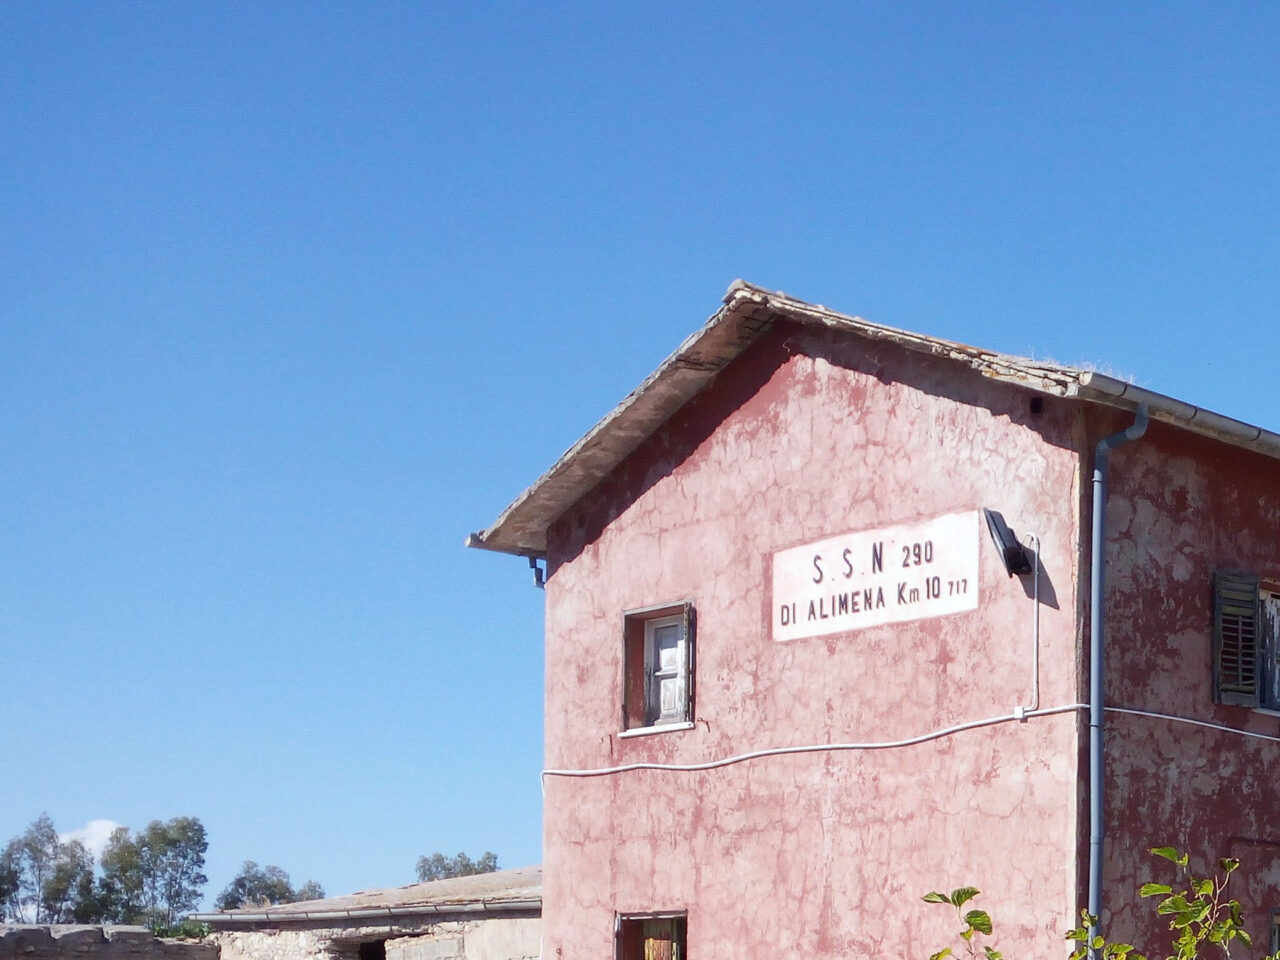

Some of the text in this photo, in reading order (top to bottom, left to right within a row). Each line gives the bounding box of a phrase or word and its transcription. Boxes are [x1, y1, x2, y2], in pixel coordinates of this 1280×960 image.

[902, 541, 933, 568] 290
[780, 575, 967, 626] DI ALIMENA Km 10 717
